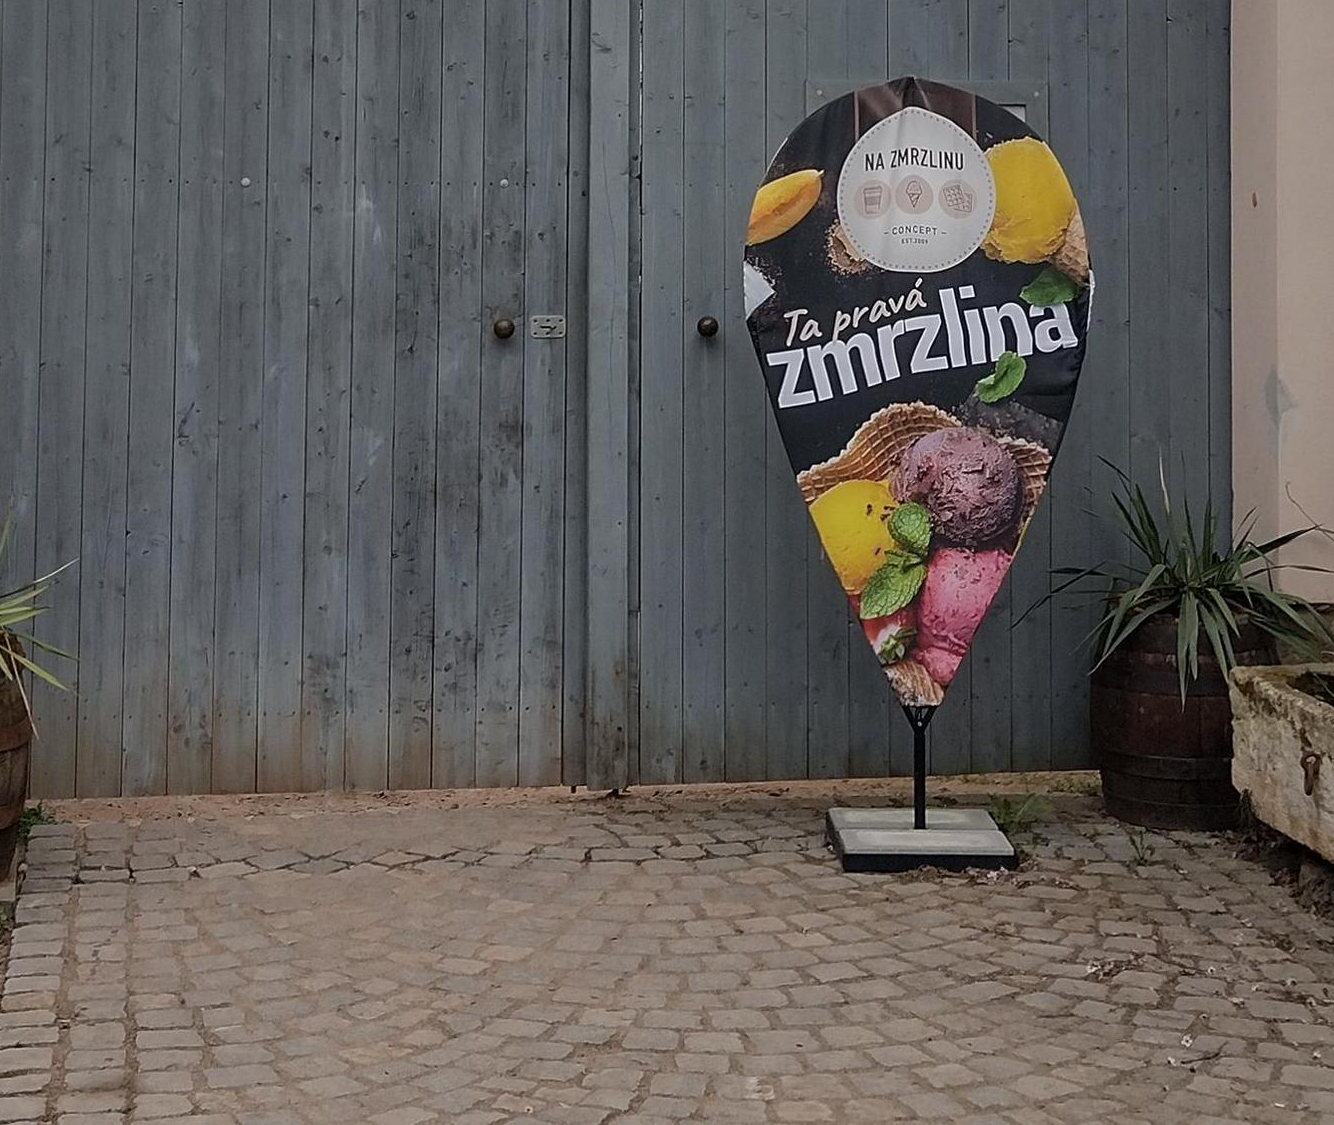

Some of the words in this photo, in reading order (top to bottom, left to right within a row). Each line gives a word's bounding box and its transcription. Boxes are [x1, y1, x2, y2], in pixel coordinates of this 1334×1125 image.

[865, 153, 885, 171] NA
[890, 147, 964, 171] ZMRZLINU
[891, 225, 938, 236] CONCEPT
[784, 309, 823, 346] Ta
[833, 278, 927, 342] pravá
[767, 285, 1079, 409] zmrzlina
